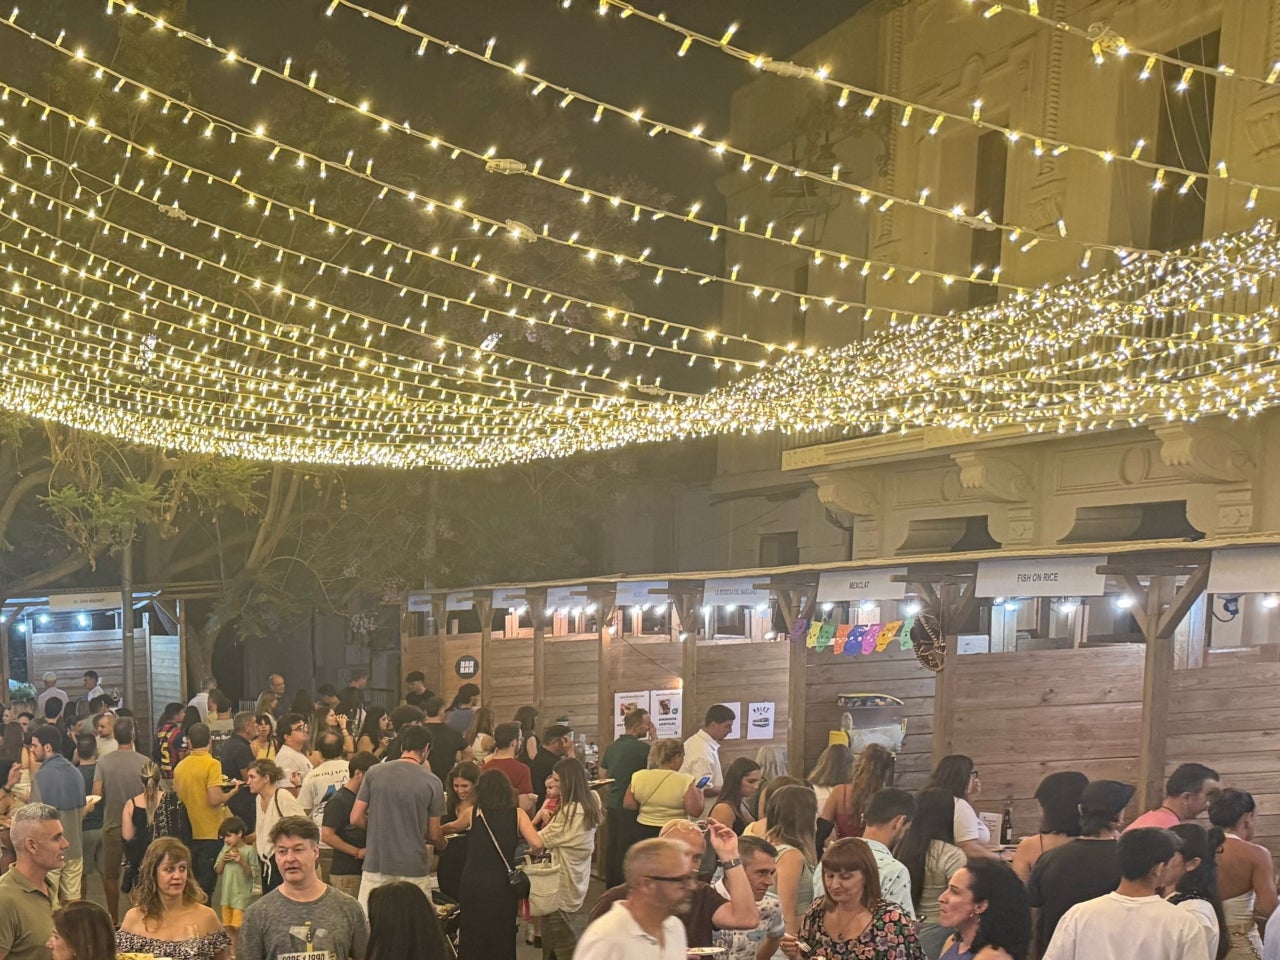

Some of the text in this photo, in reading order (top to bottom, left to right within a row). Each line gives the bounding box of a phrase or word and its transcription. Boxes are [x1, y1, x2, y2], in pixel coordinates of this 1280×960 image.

[1017, 572, 1059, 582] FISH ON RICE
[161, 743, 170, 764] 5
